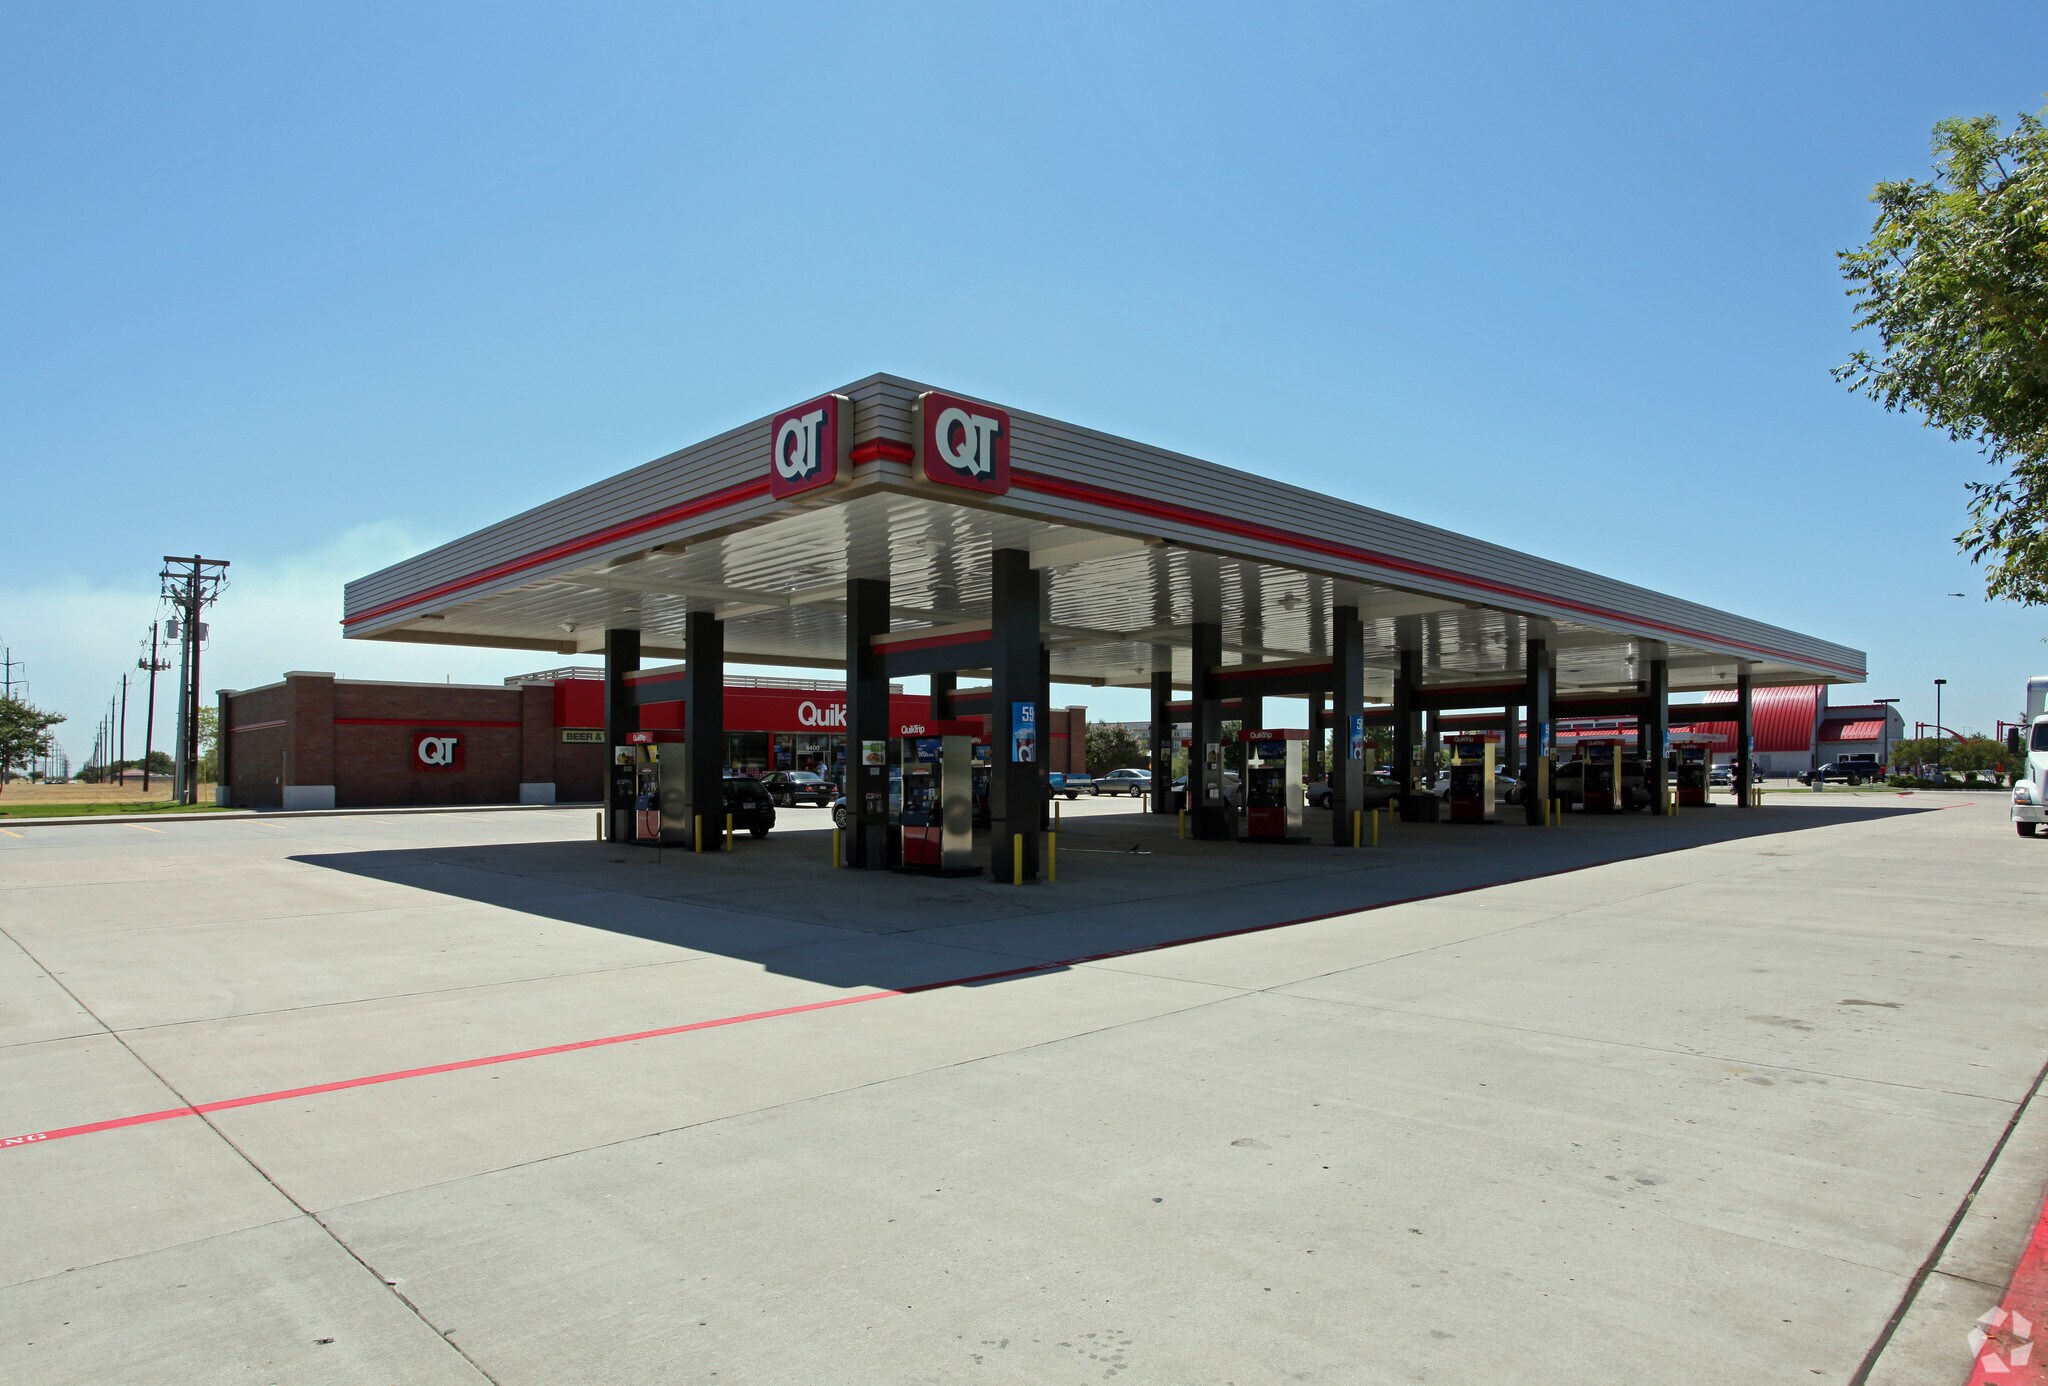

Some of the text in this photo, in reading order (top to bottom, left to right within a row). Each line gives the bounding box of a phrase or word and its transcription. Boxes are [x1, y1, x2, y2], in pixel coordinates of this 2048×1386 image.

[775, 409, 823, 479] QT
[935, 407, 998, 477] QT
[798, 701, 847, 727] Quik
[566, 733, 602, 741] BEER &
[901, 724, 926, 735] QuikTrip
[1250, 731, 1272, 740] QuikTrip
[418, 736, 458, 765] QT
